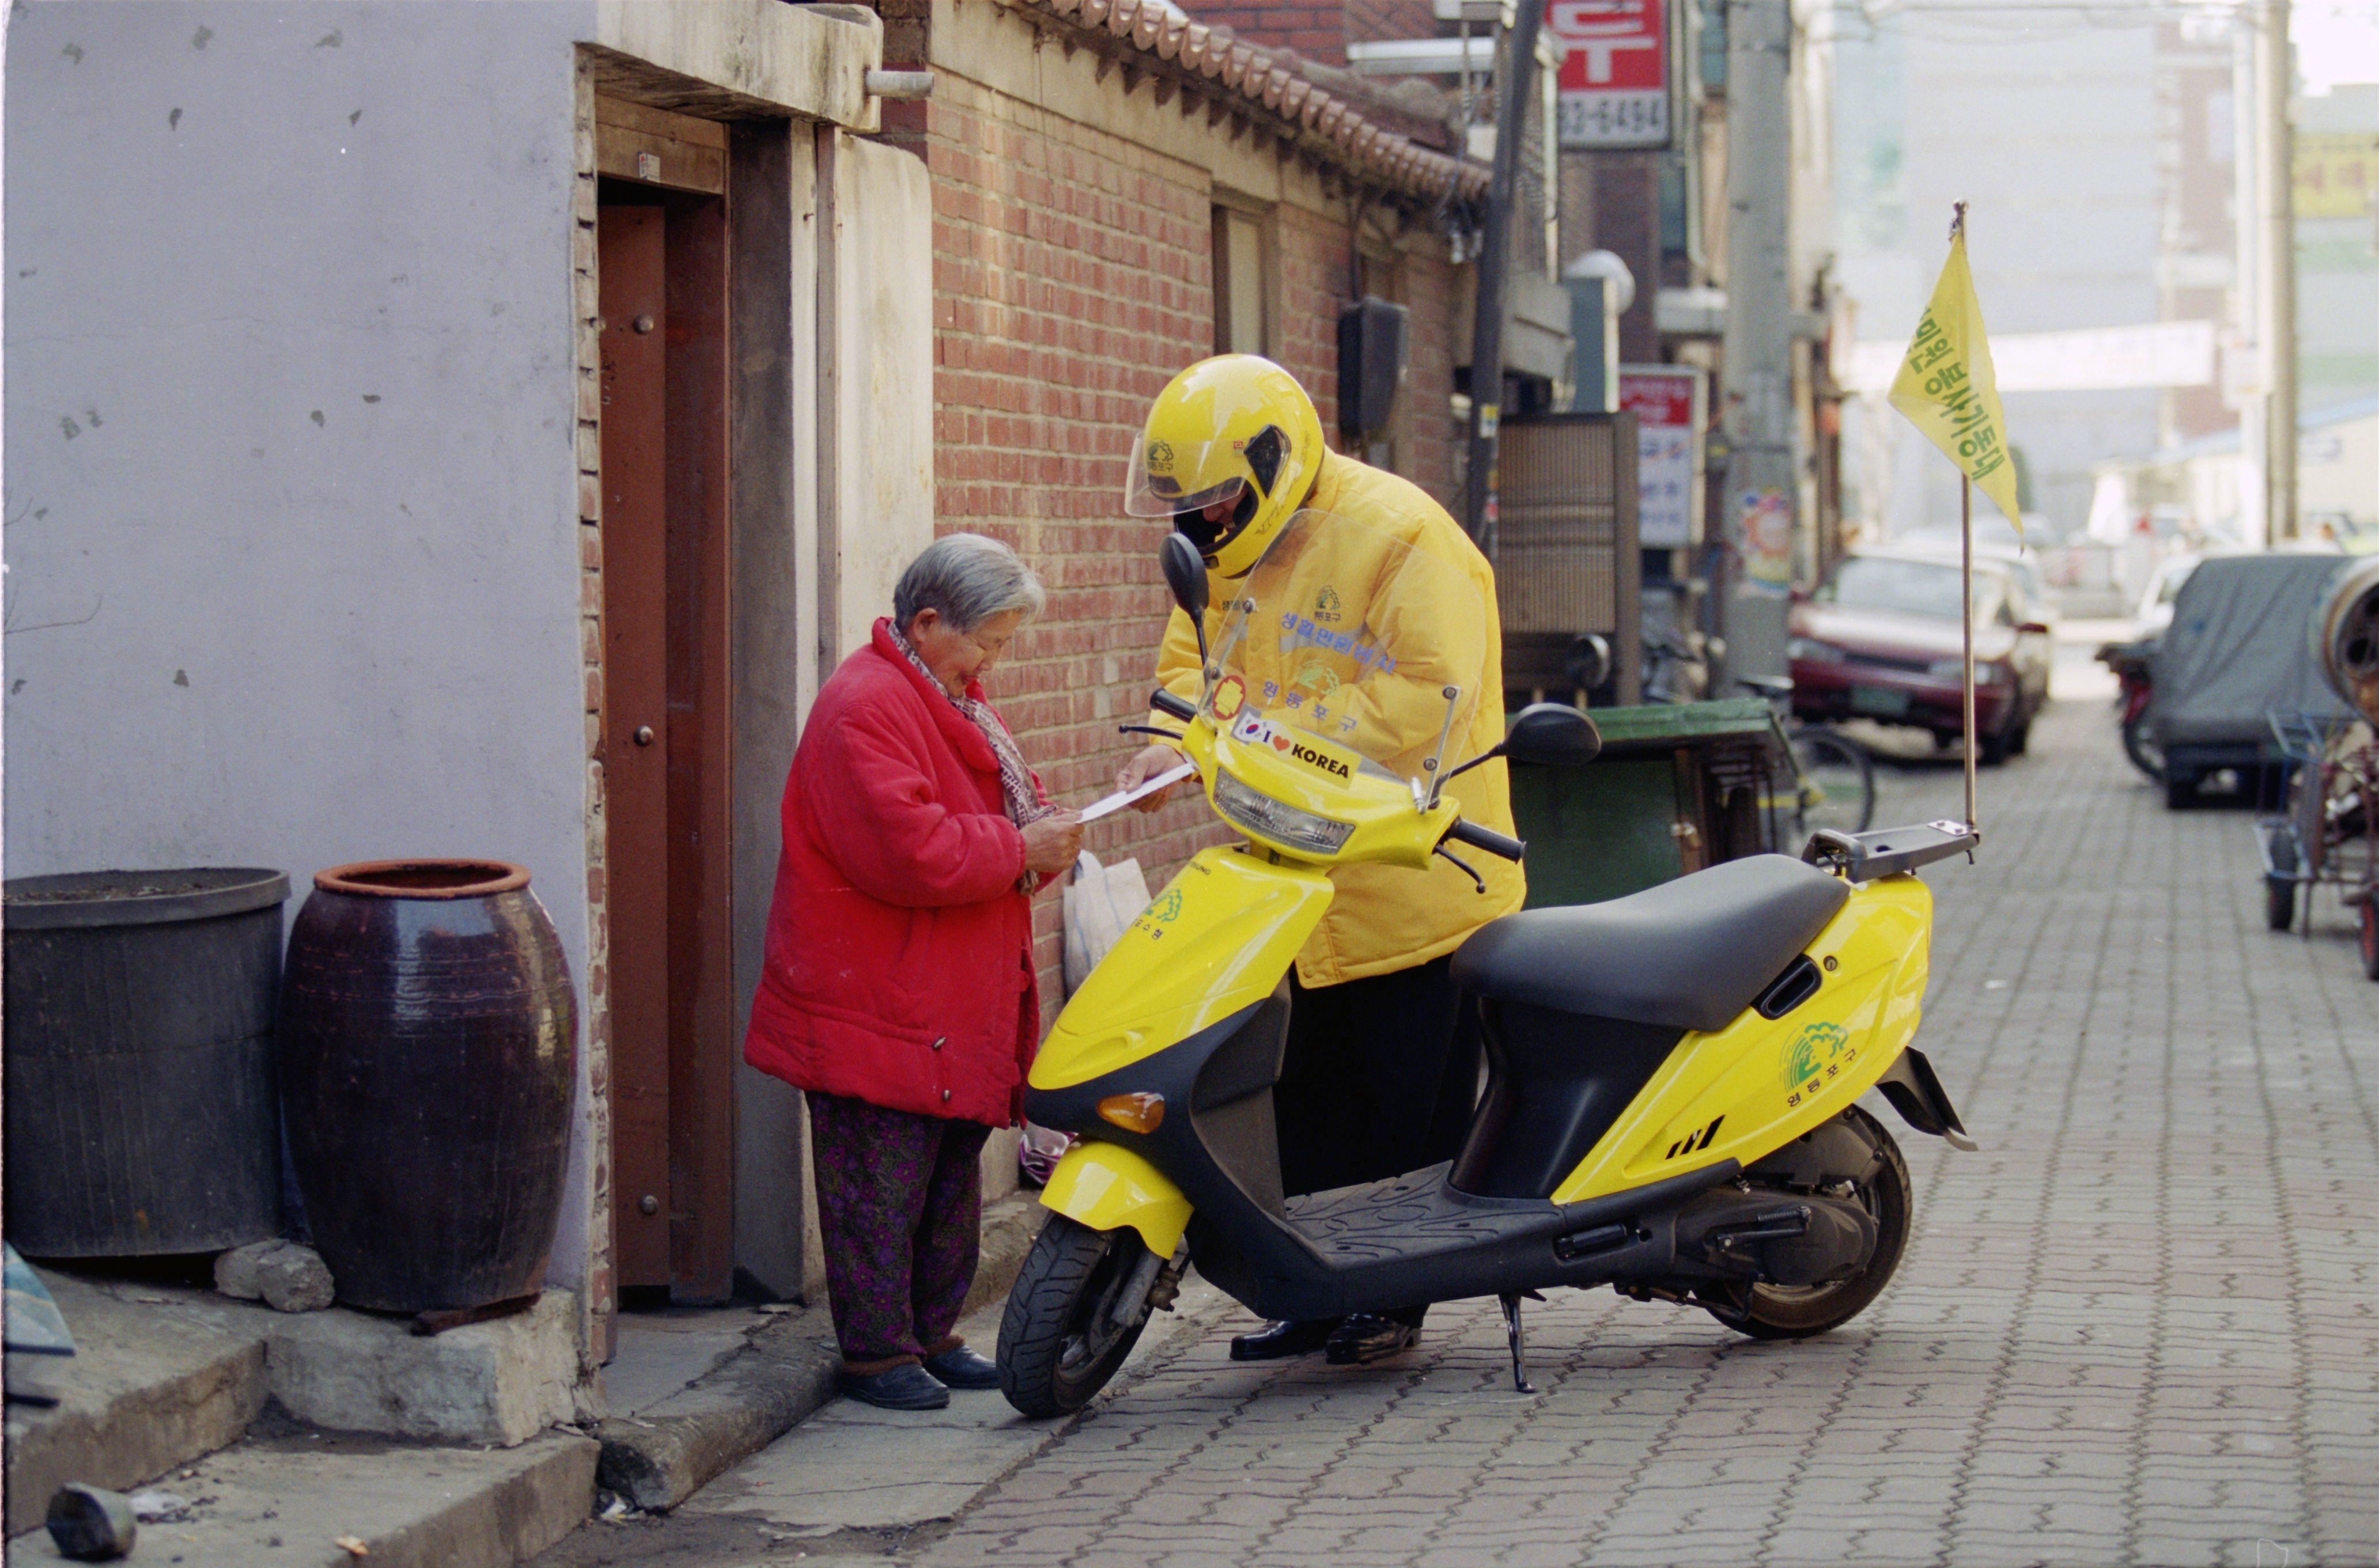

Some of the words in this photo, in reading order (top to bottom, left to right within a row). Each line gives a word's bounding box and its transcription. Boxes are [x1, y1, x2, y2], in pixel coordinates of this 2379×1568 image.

[1907, 306, 2006, 482] 민원봉사기동대
[1263, 681, 1357, 732] 영등포구
[1263, 730, 1272, 743] I
[1291, 743, 1349, 778] KOREA
[1787, 1048, 1856, 1107] 영등포구
